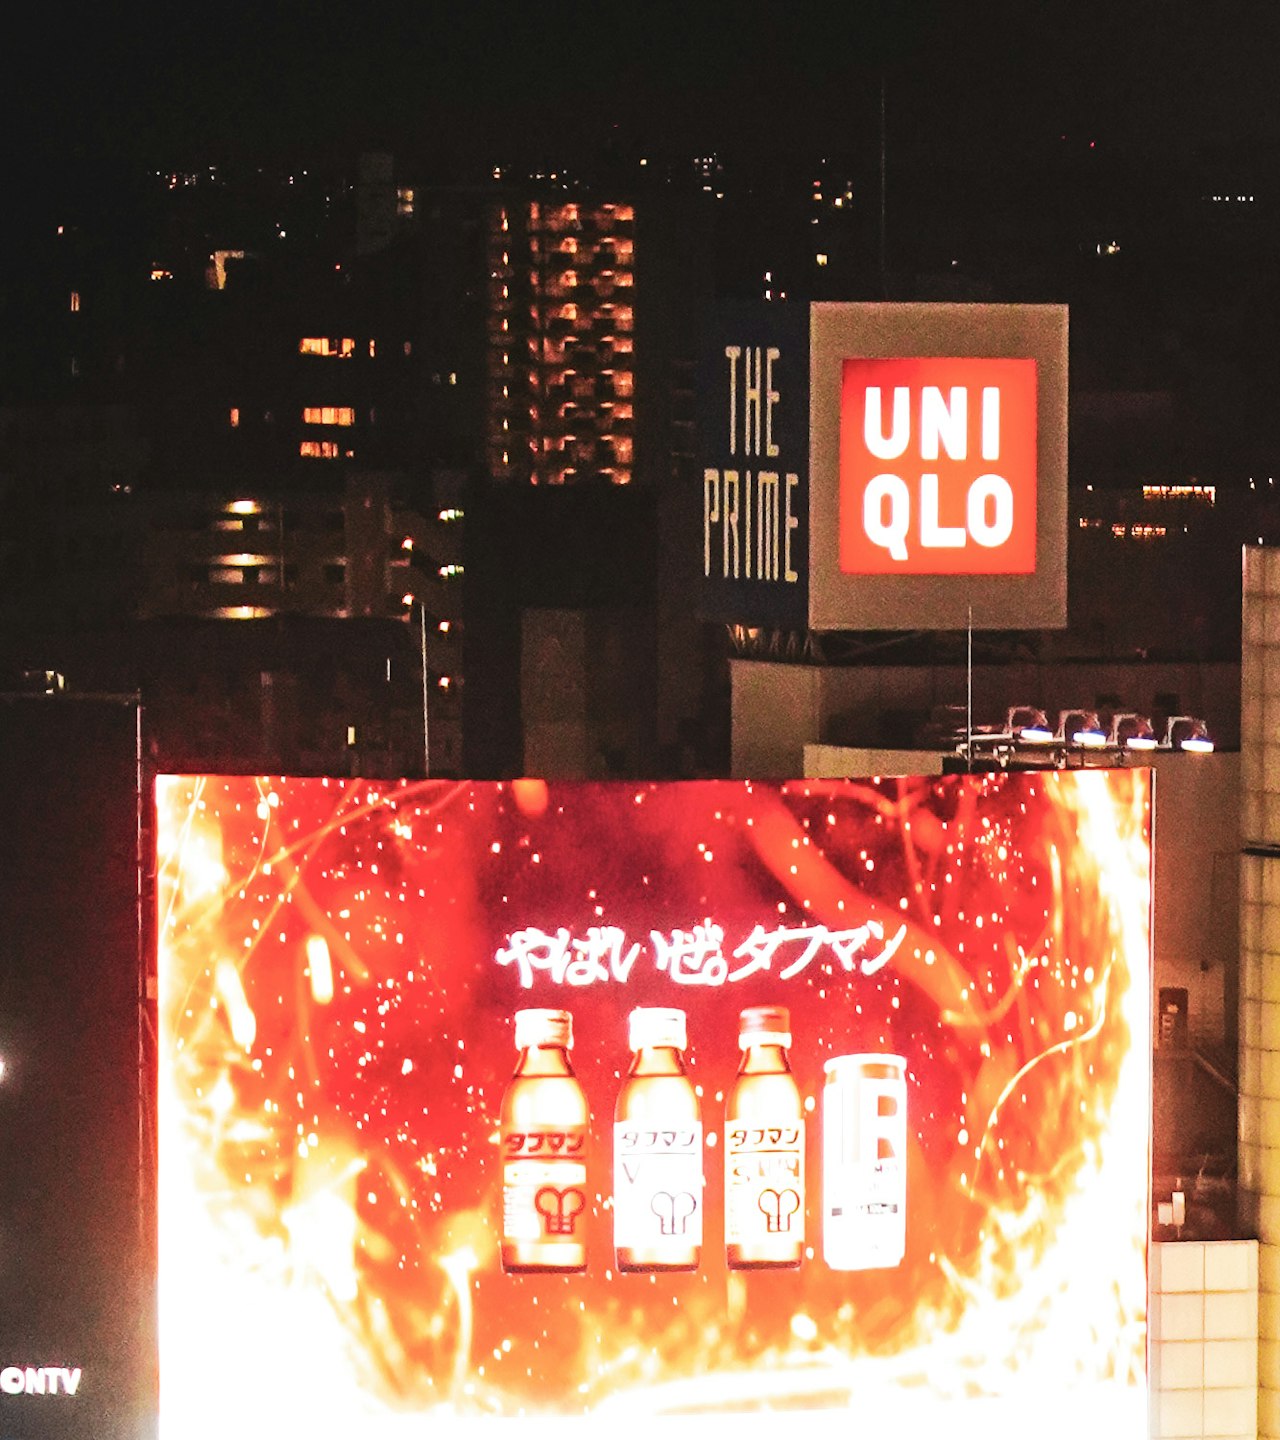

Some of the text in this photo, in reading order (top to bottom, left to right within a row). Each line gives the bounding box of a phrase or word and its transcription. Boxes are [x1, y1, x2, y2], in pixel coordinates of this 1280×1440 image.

[724, 345, 781, 457] THE
[863, 386, 1001, 461] UNI
[704, 468, 799, 583] PRIME
[862, 474, 1014, 562] QLO
